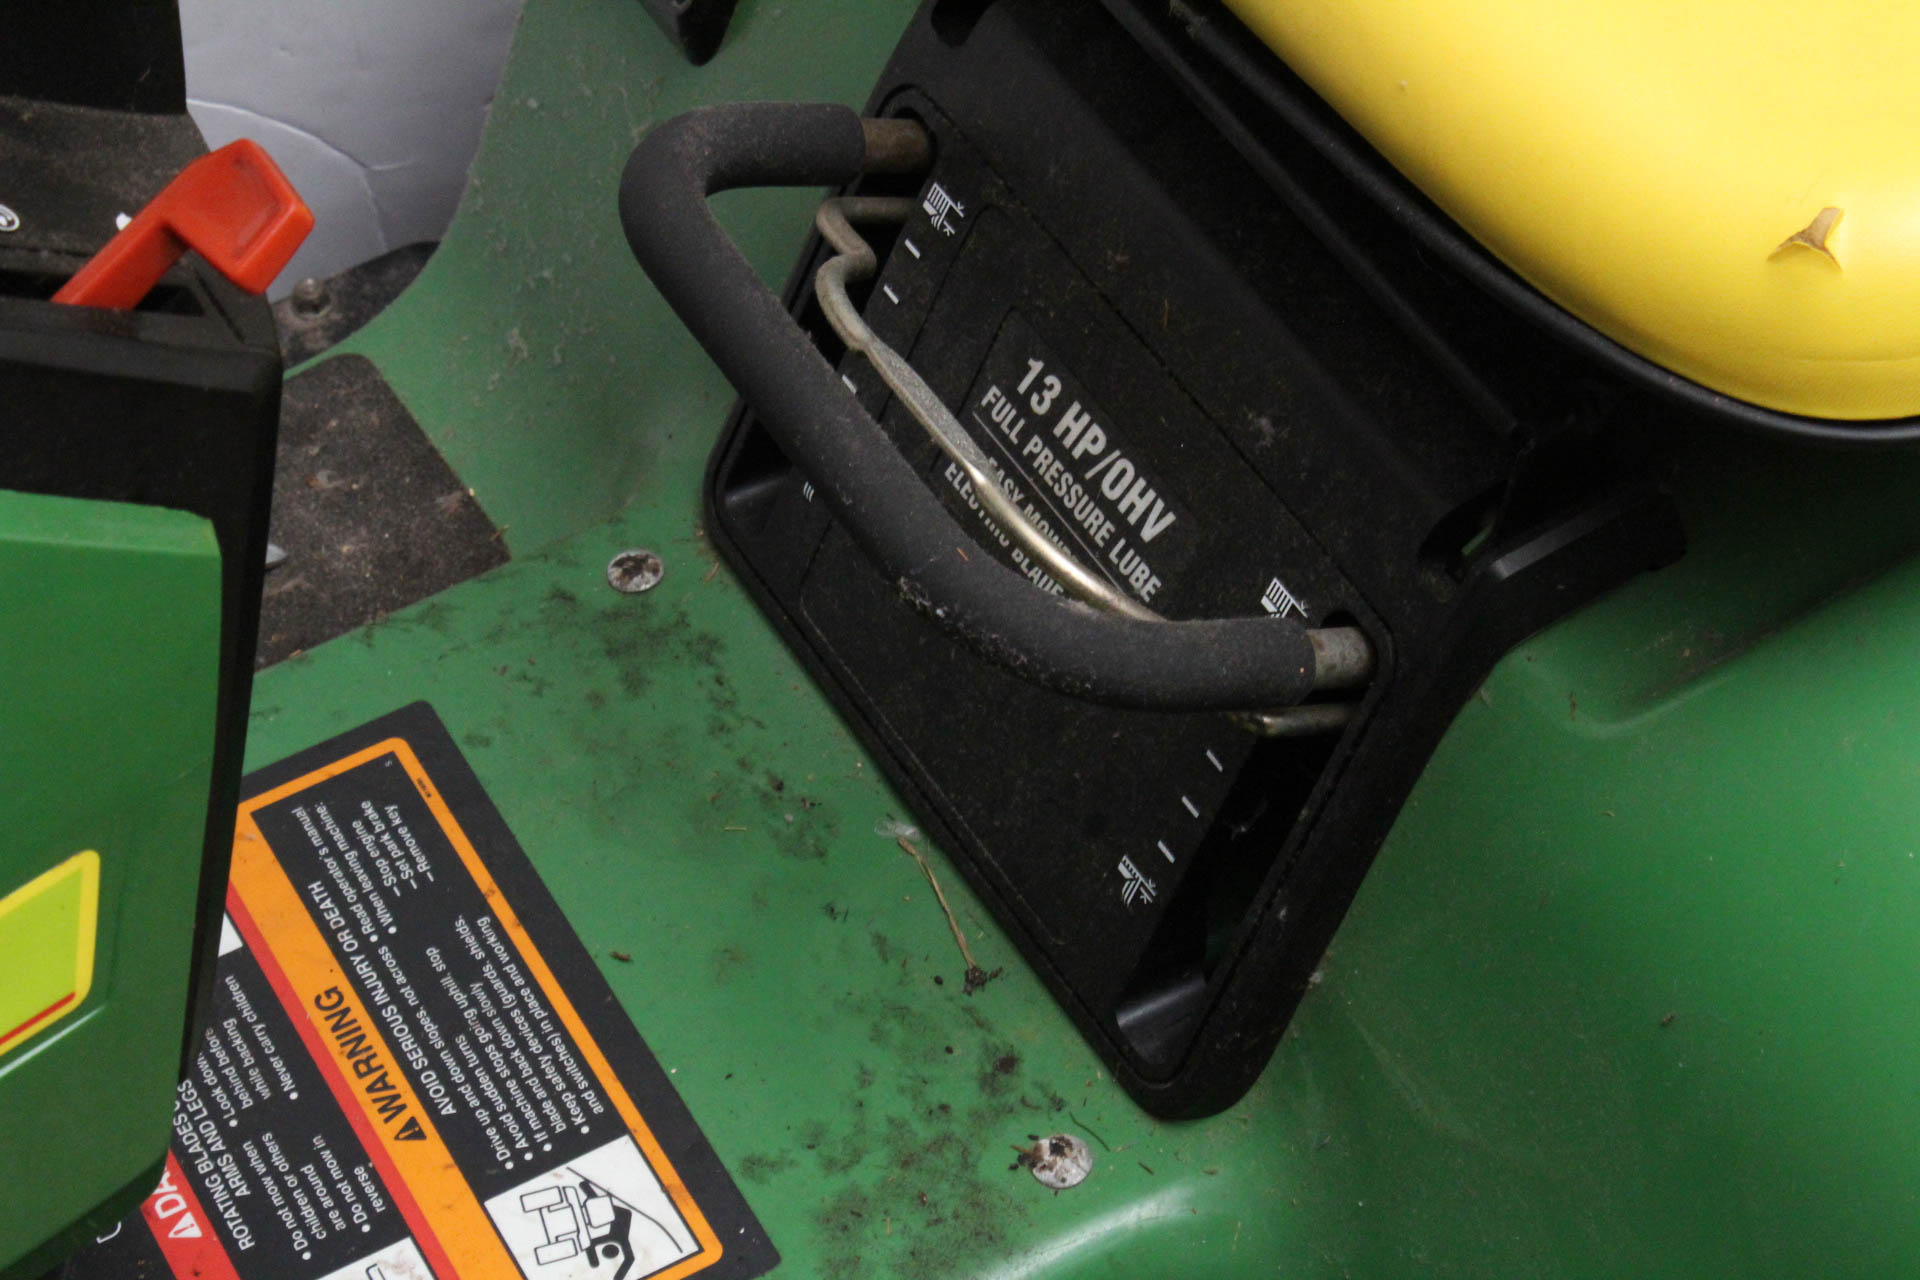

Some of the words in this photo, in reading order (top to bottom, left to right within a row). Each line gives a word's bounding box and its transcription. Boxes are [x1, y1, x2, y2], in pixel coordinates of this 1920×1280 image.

[1017, 358, 1062, 415] 13
[1053, 401, 1176, 543] HP/OHV
[981, 385, 1025, 444] FULL
[1022, 434, 1115, 547] PRESSURE
[1109, 538, 1162, 602] LUBE
[291, 806, 324, 847] manual
[315, 802, 350, 851] machine:
[361, 801, 386, 834] brake
[384, 805, 402, 827] key
[352, 820, 380, 858] engine
[379, 832, 405, 859] park
[318, 846, 357, 903] operator's
[344, 850, 374, 893] leaving
[308, 881, 345, 930] DEATH
[349, 903, 375, 935] Read
[369, 892, 393, 927] When
[337, 929, 358, 952] OR
[476, 916, 510, 964] working
[378, 945, 407, 985] across
[426, 947, 446, 972] stop
[502, 963, 525, 987] and
[350, 954, 390, 1005] INJURY
[399, 985, 419, 1006] not
[225, 975, 257, 1023] children
[469, 982, 497, 1018] slowly
[520, 987, 548, 1020] place
[251, 1023, 275, 1054] carry
[382, 1005, 428, 1070] SERIOUS
[463, 1008, 493, 1043] going
[492, 1017, 516, 1049] down
[510, 1008, 543, 1054] devices
[540, 1020, 553, 1034] in
[222, 1018, 255, 1068] backing
[314, 986, 407, 1124] WARNING
[455, 1034, 479, 1068] turns
[269, 1056, 295, 1092] Never
[440, 1049, 465, 1083] down
[484, 1044, 511, 1078] stops
[510, 1048, 533, 1078] back
[538, 1055, 566, 1091] safety
[546, 1033, 589, 1090] switches)
[177, 1079, 208, 1121] LEGS
[221, 1066, 253, 1109] behind
[248, 1067, 271, 1100] while
[420, 1070, 457, 1115] AVOID
[457, 1083, 480, 1108] and
[475, 1067, 507, 1112] sudden
[525, 1076, 547, 1100] and
[211, 1086, 235, 1119] Look
[475, 1108, 491, 1126] up
[506, 1079, 542, 1131] machine
[542, 1100, 567, 1133] blade
[561, 1092, 586, 1126] Keep
[581, 1090, 604, 1114] and
[173, 1113, 214, 1174] BLADES
[199, 1120, 226, 1152] AND
[312, 1135, 326, 1150] in
[486, 1127, 511, 1161] Drive
[499, 1112, 529, 1149] Avoid
[534, 1131, 548, 1142] If
[242, 1140, 267, 1175] when
[262, 1132, 289, 1172] others
[320, 1149, 343, 1180] mow
[217, 1154, 251, 1196] ARMS
[261, 1176, 285, 1207] mow
[283, 1174, 298, 1188] or
[300, 1164, 334, 1209] around
[336, 1180, 356, 1203] not
[354, 1166, 386, 1213] reverse
[205, 1173, 255, 1250] ROTATING
[277, 1206, 297, 1229] not
[293, 1188, 327, 1240] children
[328, 1209, 346, 1231] are
[351, 1203, 368, 1224] Do
[292, 1230, 308, 1251] Do
